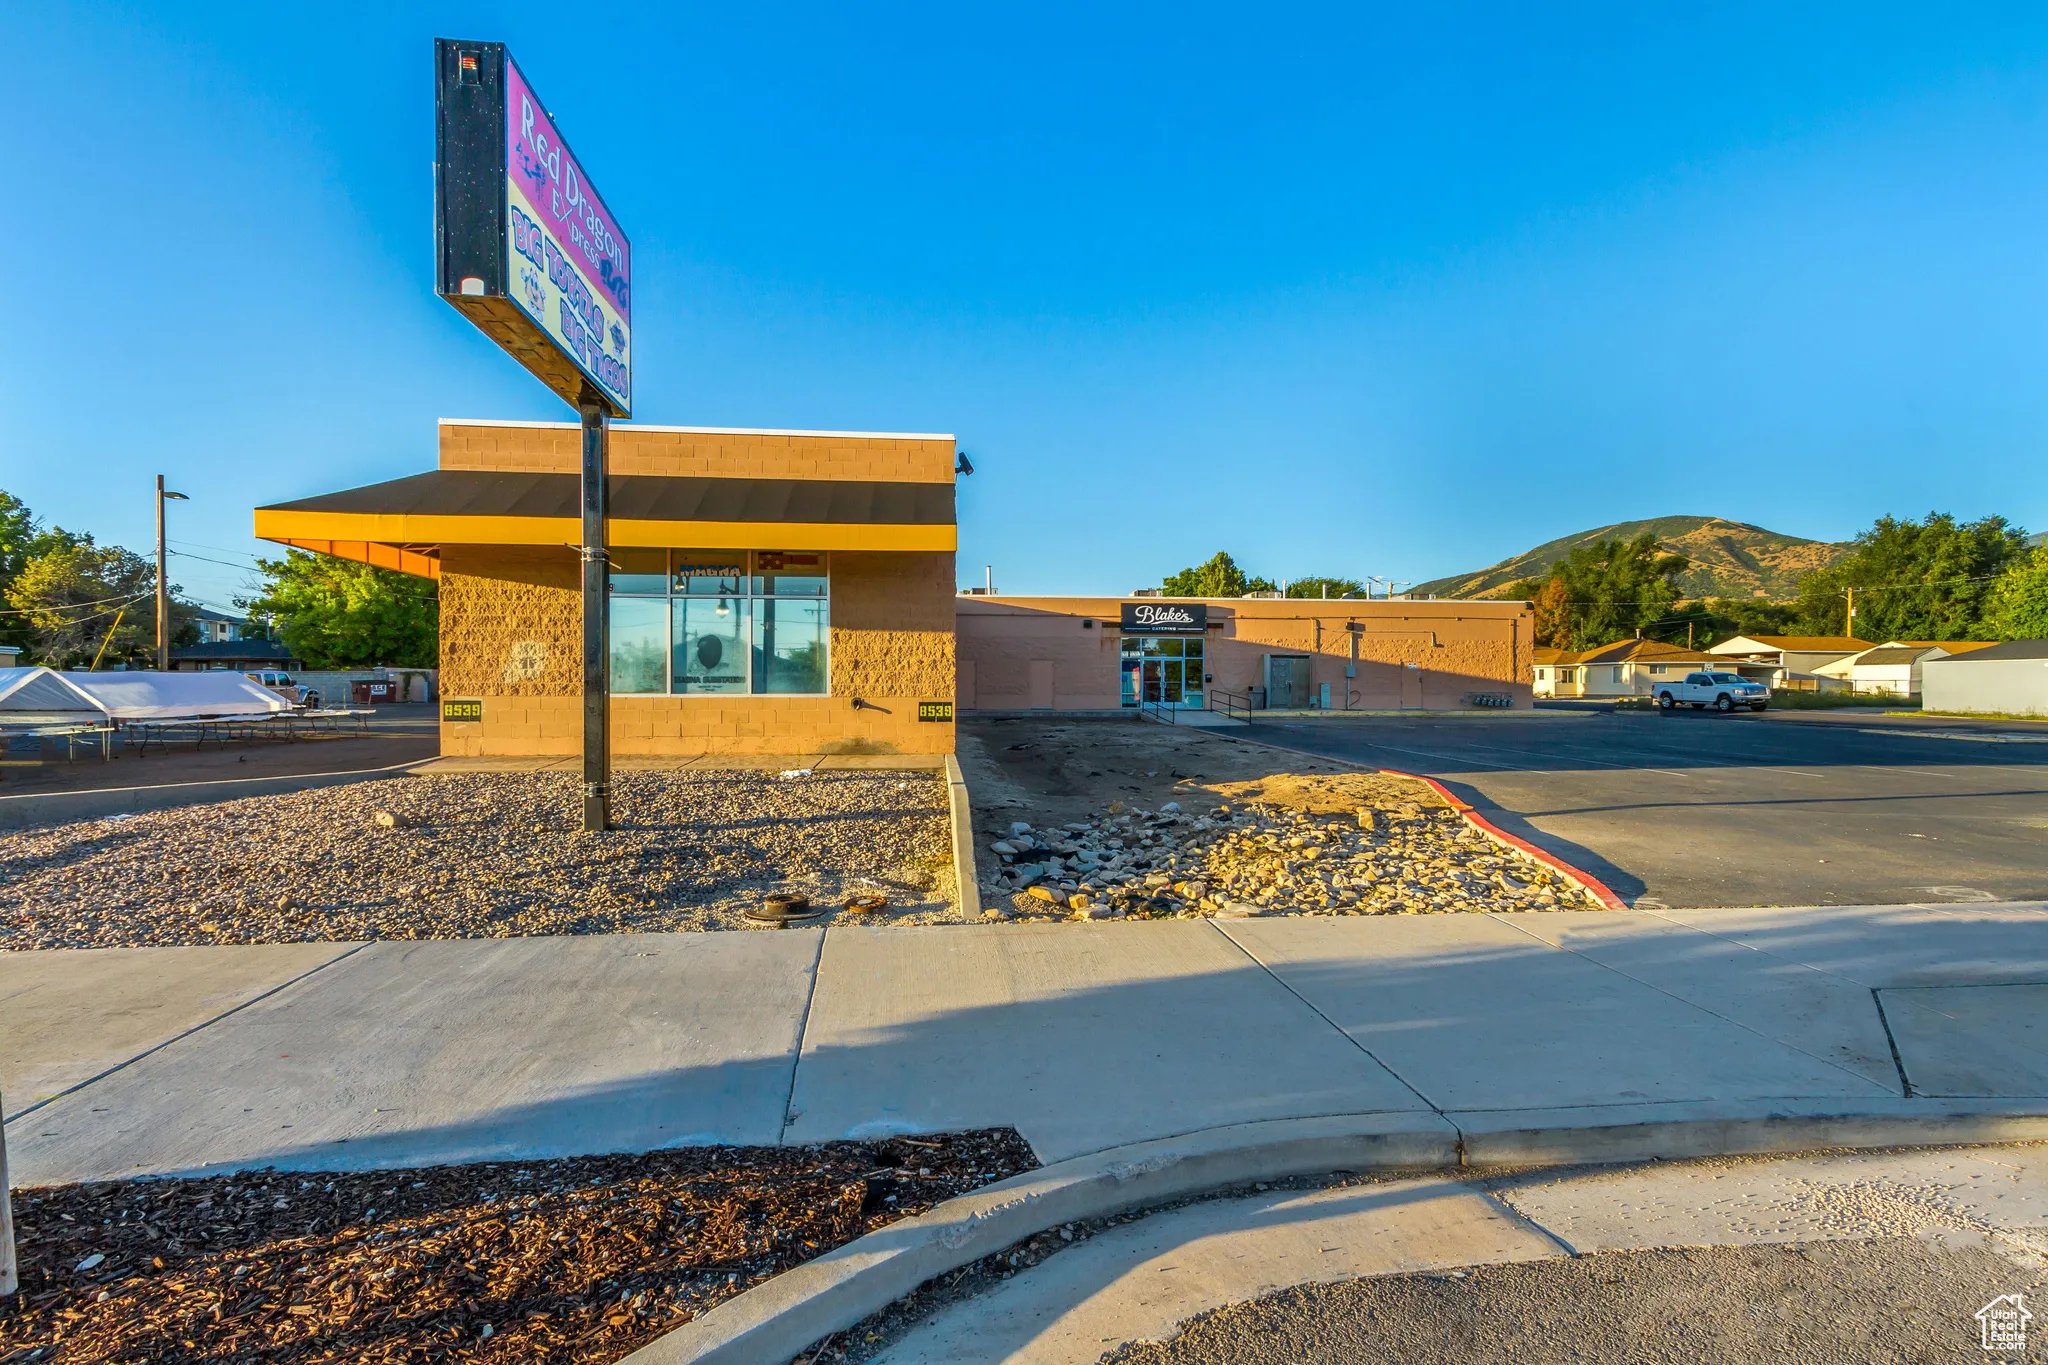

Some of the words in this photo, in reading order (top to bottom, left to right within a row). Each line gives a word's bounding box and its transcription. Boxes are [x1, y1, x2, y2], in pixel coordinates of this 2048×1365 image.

[521, 93, 561, 186] Red
[565, 160, 623, 273] Dragon
[511, 204, 544, 273] BIG
[545, 235, 605, 344] TORTAS
[560, 297, 586, 365] BIG
[587, 336, 628, 400] TACOS
[680, 564, 741, 577] MAGNA
[1135, 605, 1194, 625] Blake's
[444, 704, 480, 716] 8539
[919, 705, 952, 717] 8539
